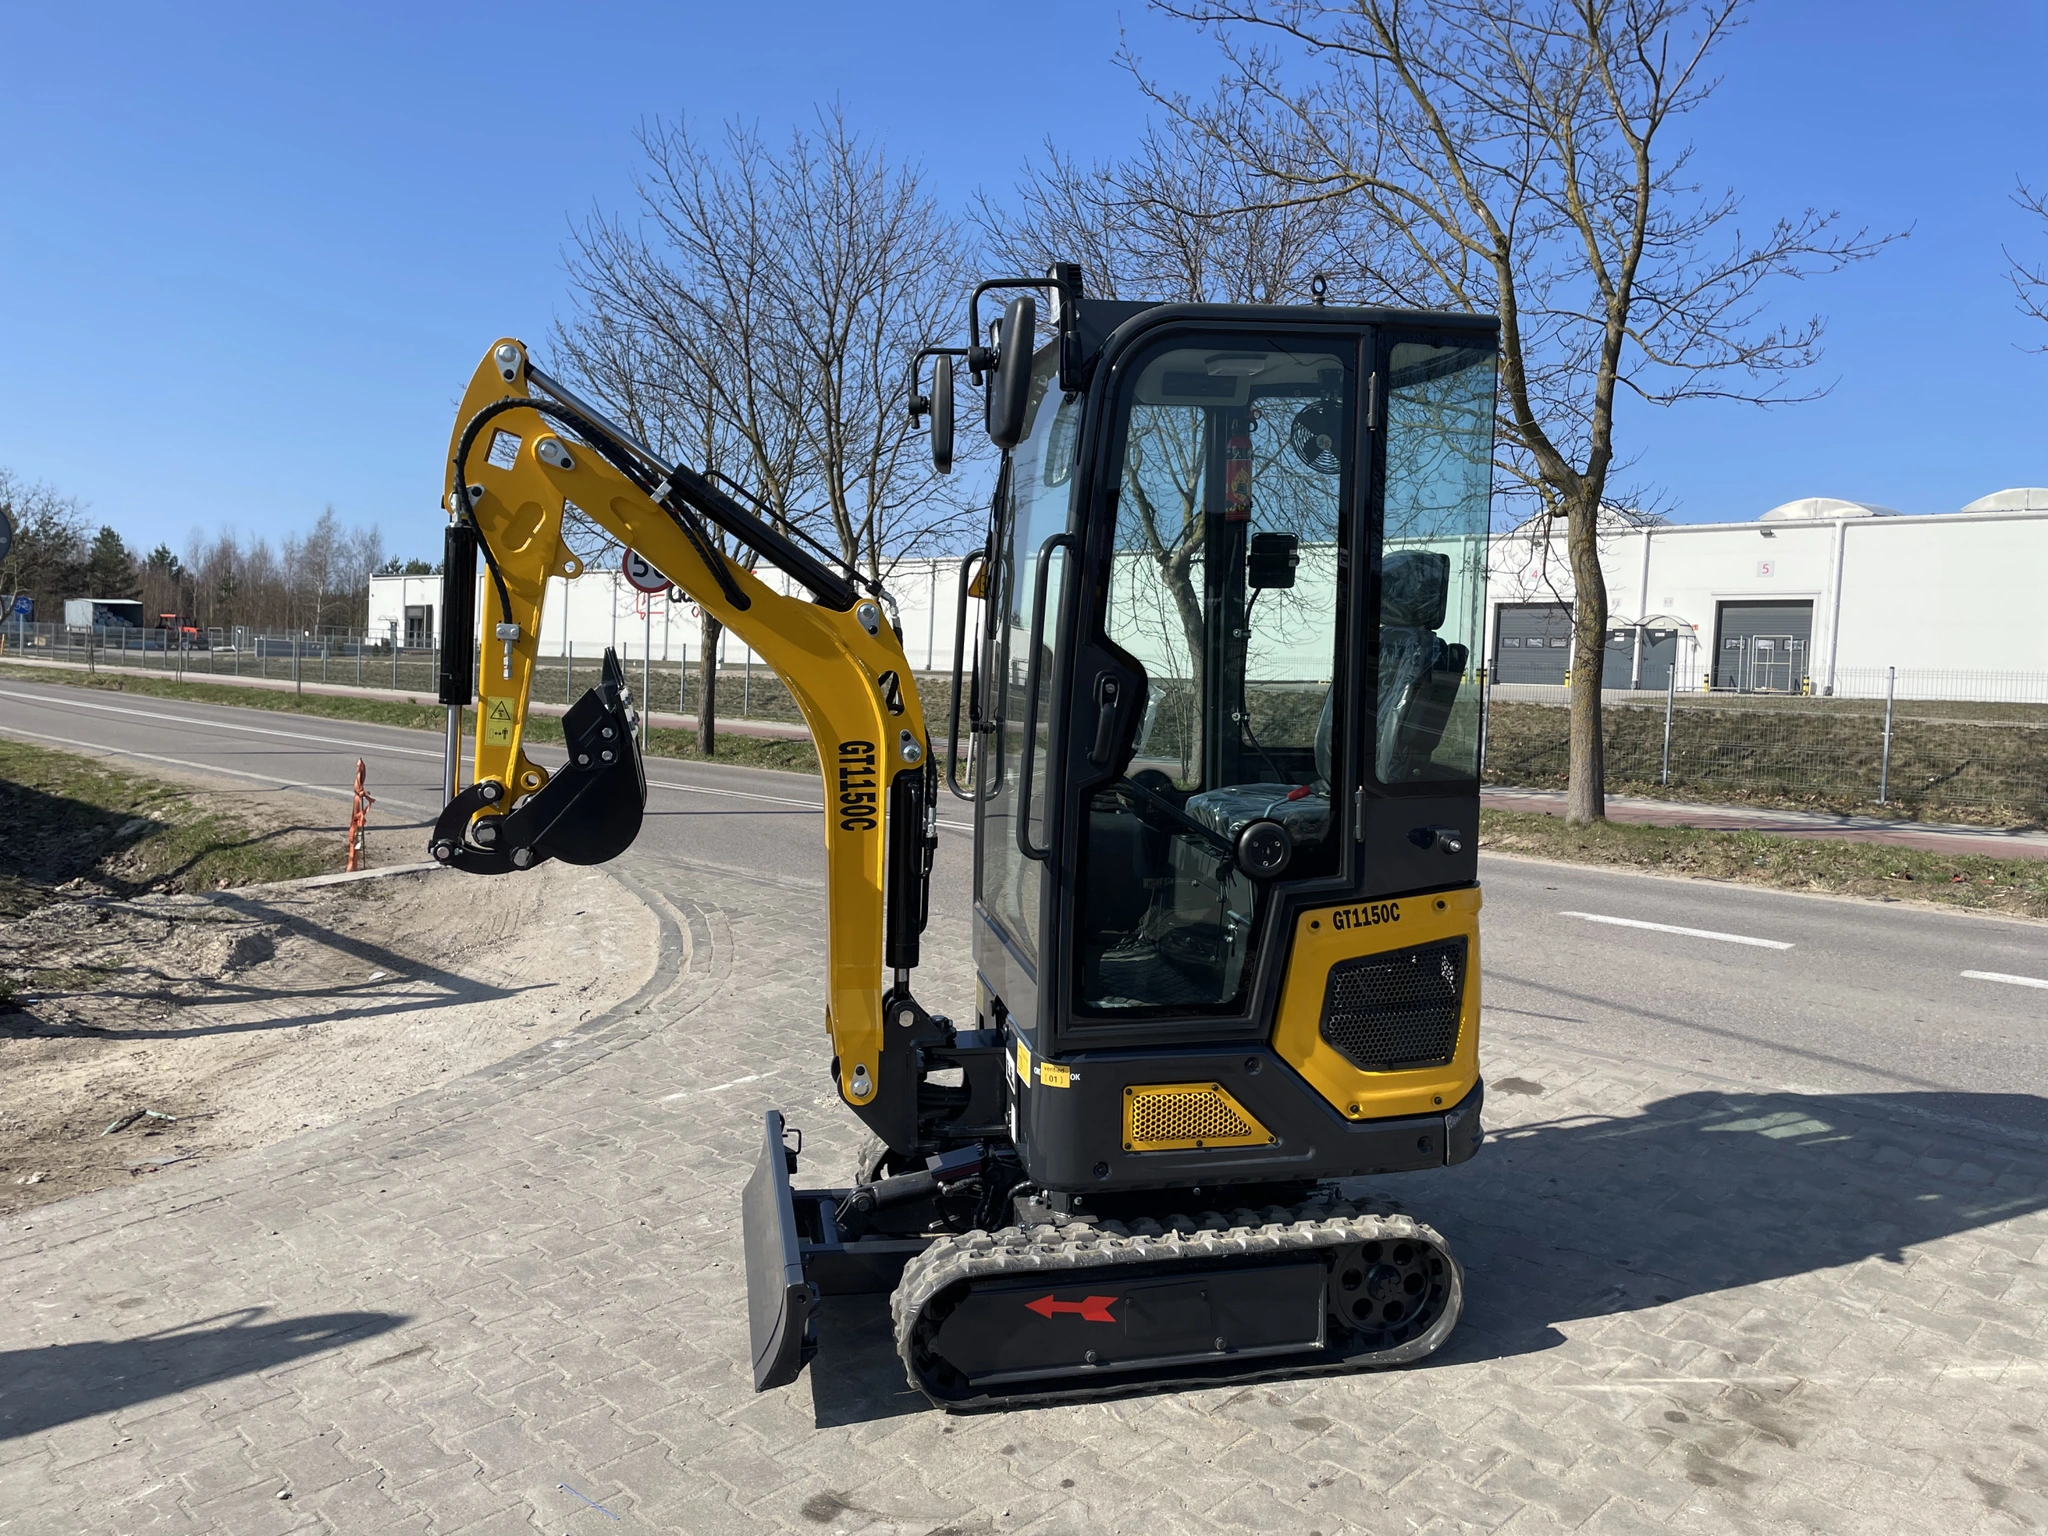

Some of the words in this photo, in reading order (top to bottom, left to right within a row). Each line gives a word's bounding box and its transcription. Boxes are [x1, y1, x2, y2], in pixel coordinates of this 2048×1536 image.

[1531, 569, 1539, 580] 4
[1761, 563, 1770, 575] 5
[838, 740, 877, 832] GT1150C
[1332, 902, 1401, 931] GT1150C
[1069, 1073, 1081, 1081] OK
